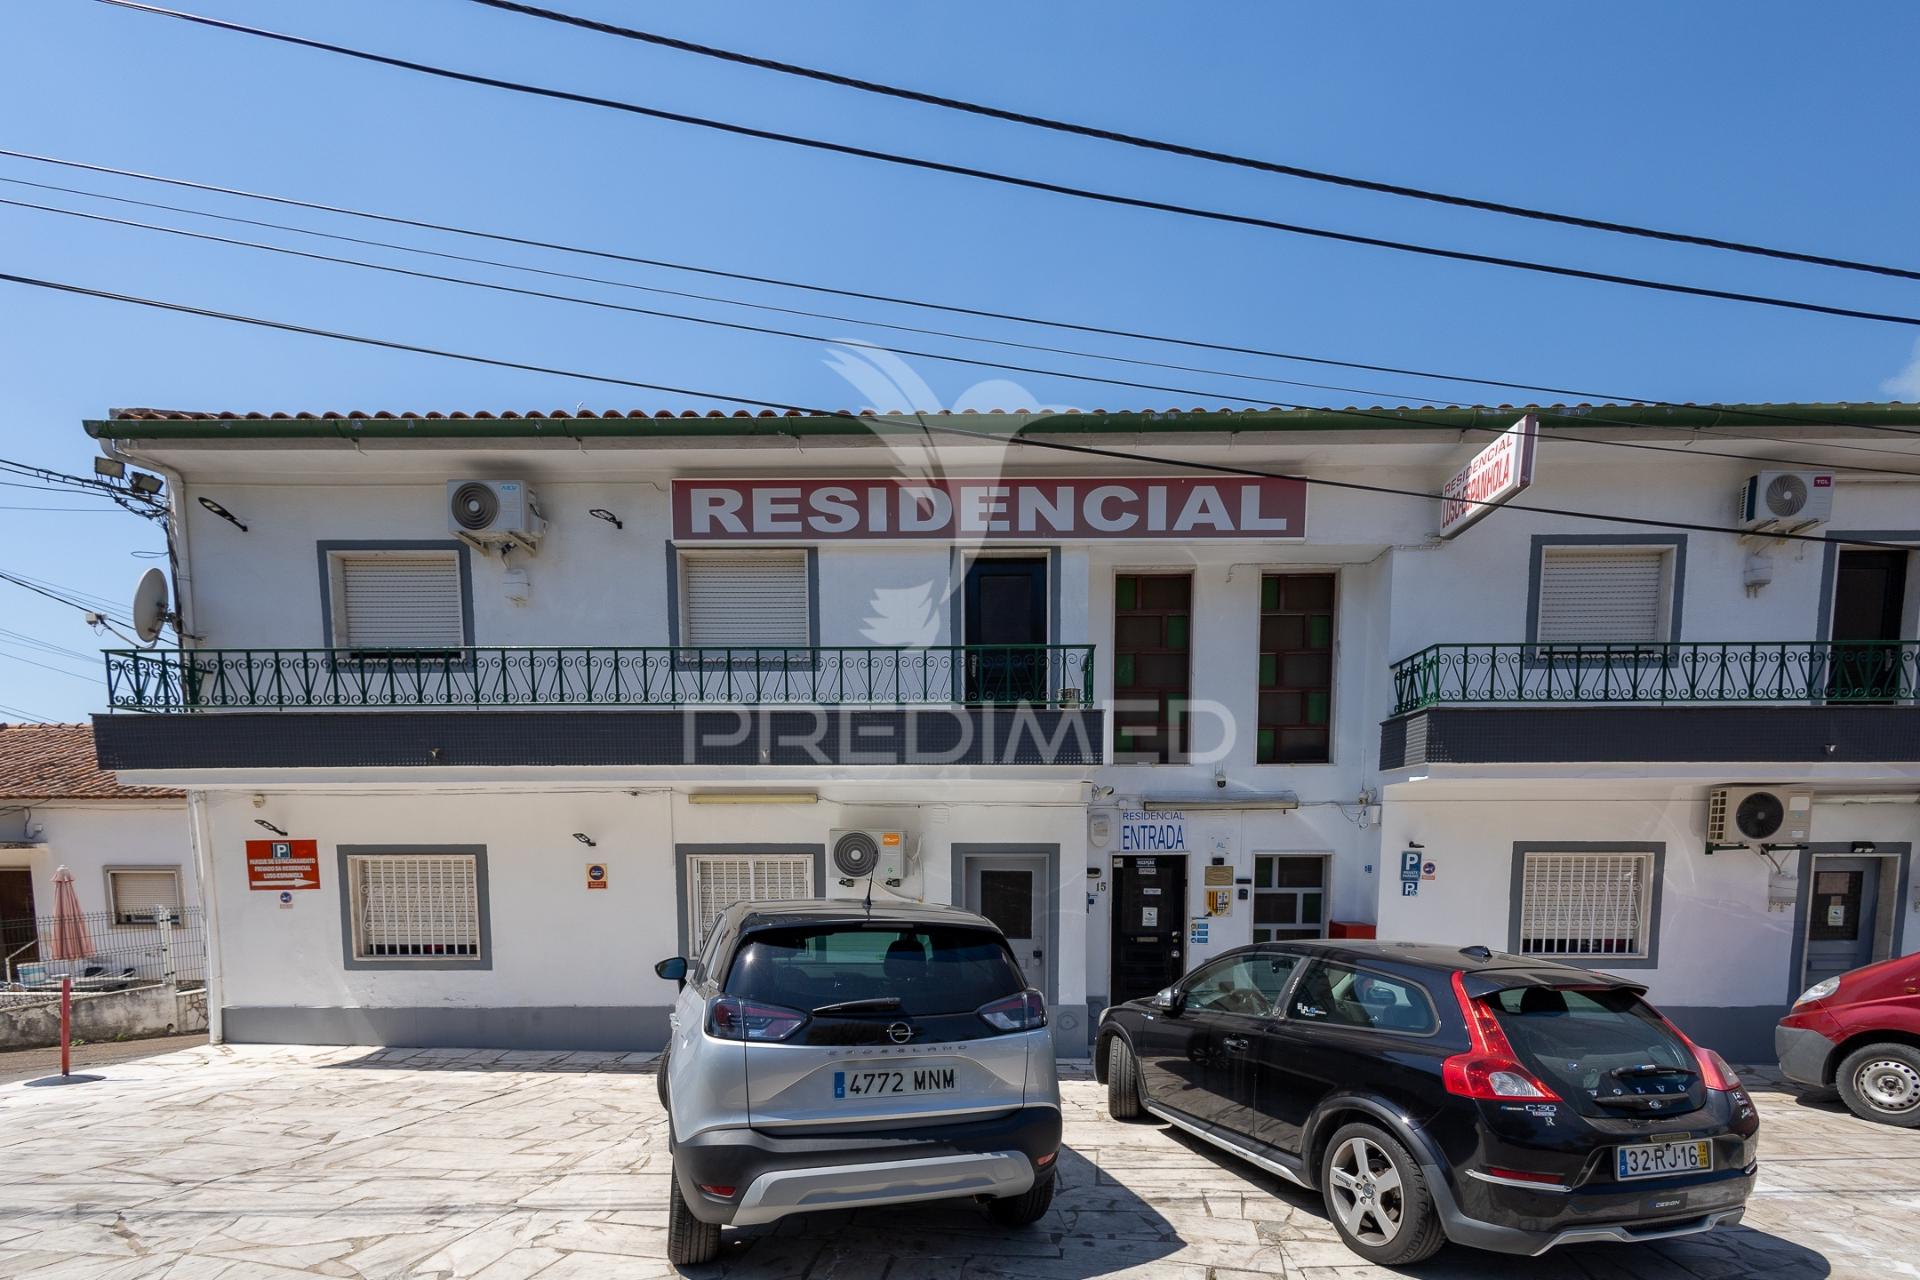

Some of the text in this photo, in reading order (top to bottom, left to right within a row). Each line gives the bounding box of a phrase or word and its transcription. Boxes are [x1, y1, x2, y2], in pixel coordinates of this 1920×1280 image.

[1444, 435, 1513, 496] RESIDENCIAL
[689, 484, 1288, 533] RESIDENCIAL
[1122, 811, 1185, 821] RESIDENCIAL
[1122, 825, 1185, 850] ENTRADA
[276, 844, 287, 858] P
[1216, 841, 1226, 849] AL
[1405, 853, 1419, 871] P
[1096, 881, 1107, 892] 15
[1404, 882, 1416, 895] P
[850, 1069, 955, 1095] 4772 MNM
[1525, 1104, 1557, 1112] C30
